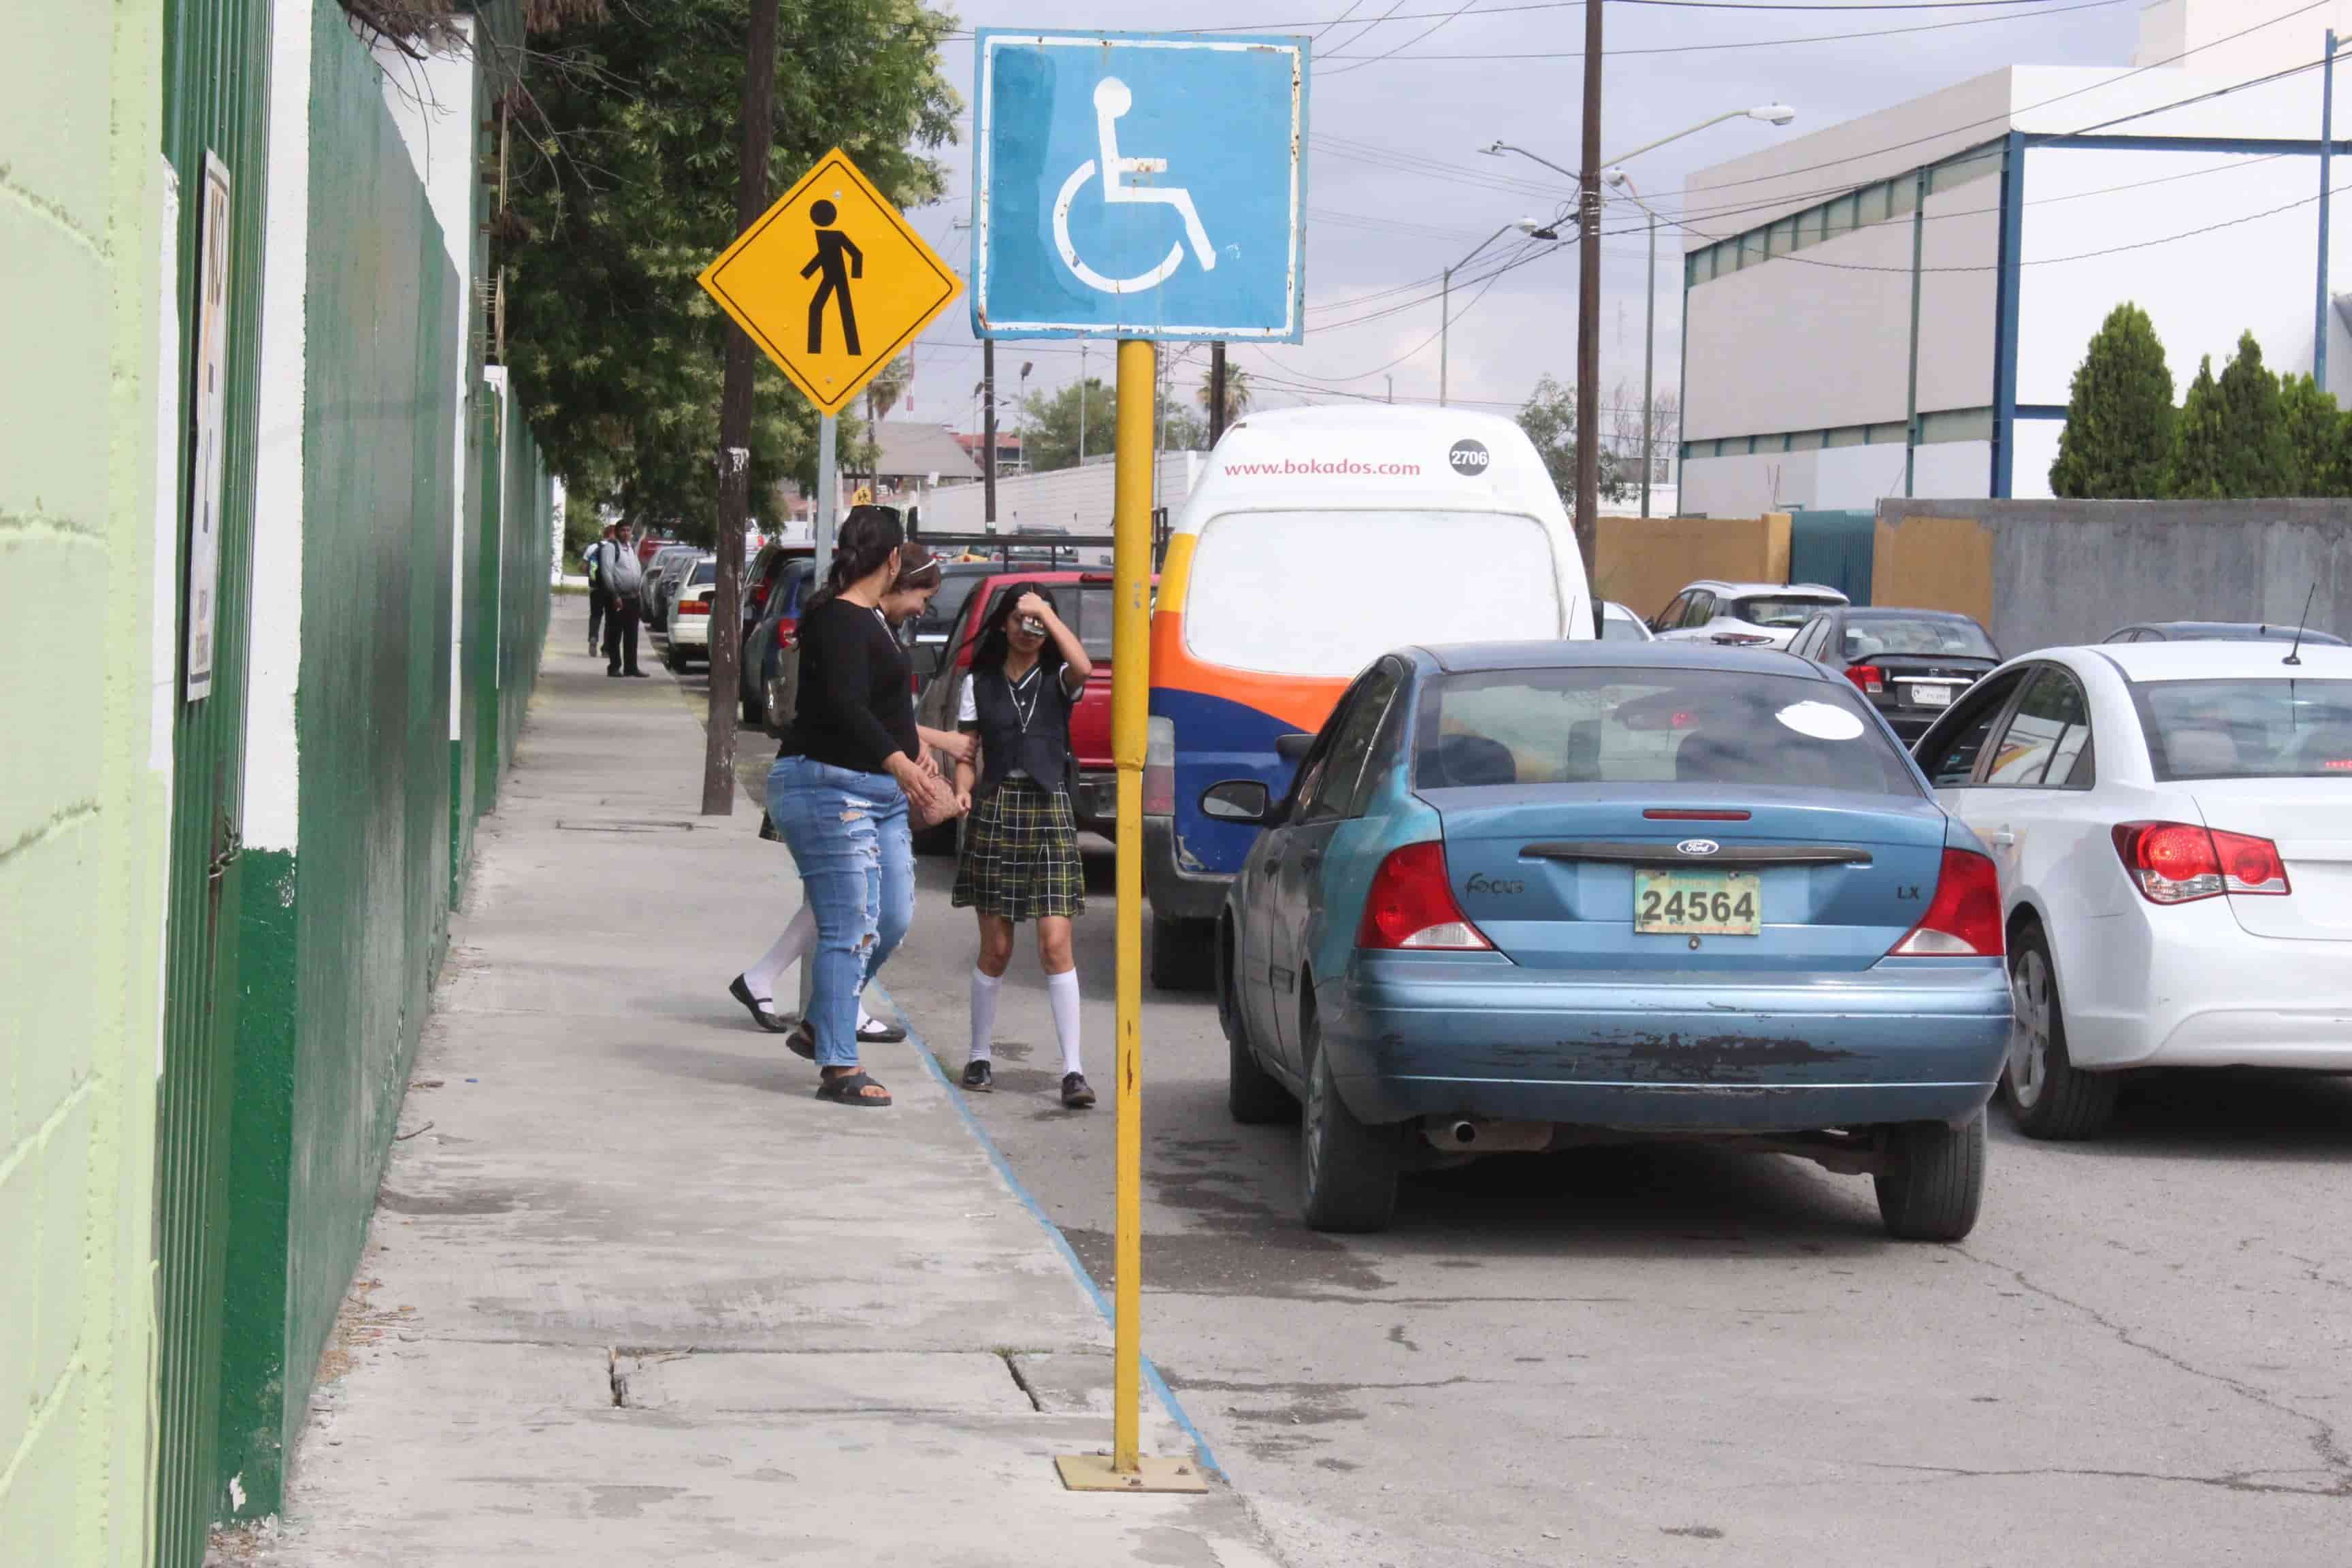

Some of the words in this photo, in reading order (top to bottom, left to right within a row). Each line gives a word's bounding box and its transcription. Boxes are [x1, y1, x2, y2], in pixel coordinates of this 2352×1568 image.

[1451, 450, 1488, 466] 2706
[1224, 458, 1421, 476] www.bokados.com
[1897, 886, 1920, 900] LX
[1642, 889, 1755, 923] 24564
